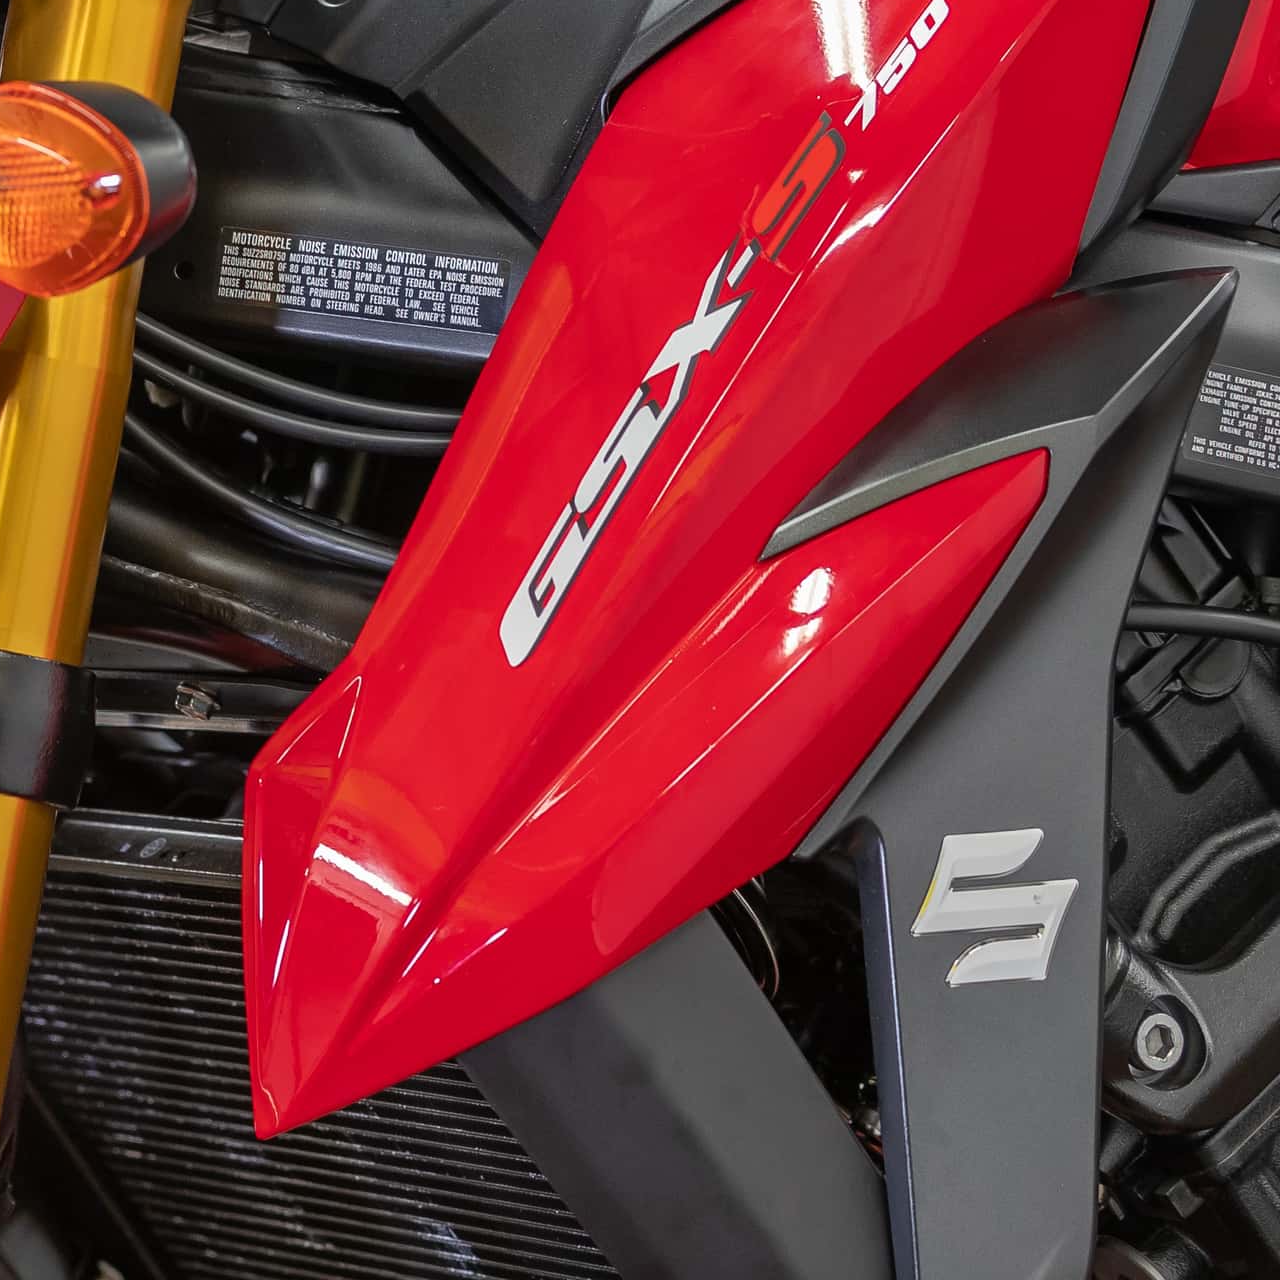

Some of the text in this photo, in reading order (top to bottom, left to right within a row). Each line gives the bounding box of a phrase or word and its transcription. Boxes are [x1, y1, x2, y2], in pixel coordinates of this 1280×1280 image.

[224, 245, 239, 256] THIS
[289, 253, 334, 267] MOTORCYCLE
[337, 259, 360, 270] MEETS
[385, 264, 400, 275] AND
[404, 266, 425, 278] LATER
[429, 269, 442, 280] EPA
[446, 271, 466, 283] NOISE
[470, 274, 505, 287] EMISSION
[232, 232, 499, 275] MOTORCYCLE NOISE EMISSION CONTROL INFORMATION
[219, 277, 479, 317] NOISE STANDARDS ARE PROHIBITED BY FEDERAL LAW. SEE VEHICLE
[221, 266, 480, 306] MODIFICATIONS WHICH CAUSE THIS MOTORCYCLE TO EXCEED FEDERAL
[222, 256, 274, 271] REQUIREMENTS
[278, 262, 287, 272] OF
[318, 266, 327, 277] AT
[355, 271, 372, 282] RPM
[375, 274, 385, 284] BY
[390, 275, 402, 286] THE
[406, 278, 436, 290] FEDERAL
[440, 281, 456, 292] TEST
[460, 284, 503, 298] PROCEDURE.
[218, 287, 482, 328] IDENTIFICATION NUMBER ON STEERING HEAD. SEE OWNER'S MANUAL.
[1208, 370, 1232, 382] EHICLE
